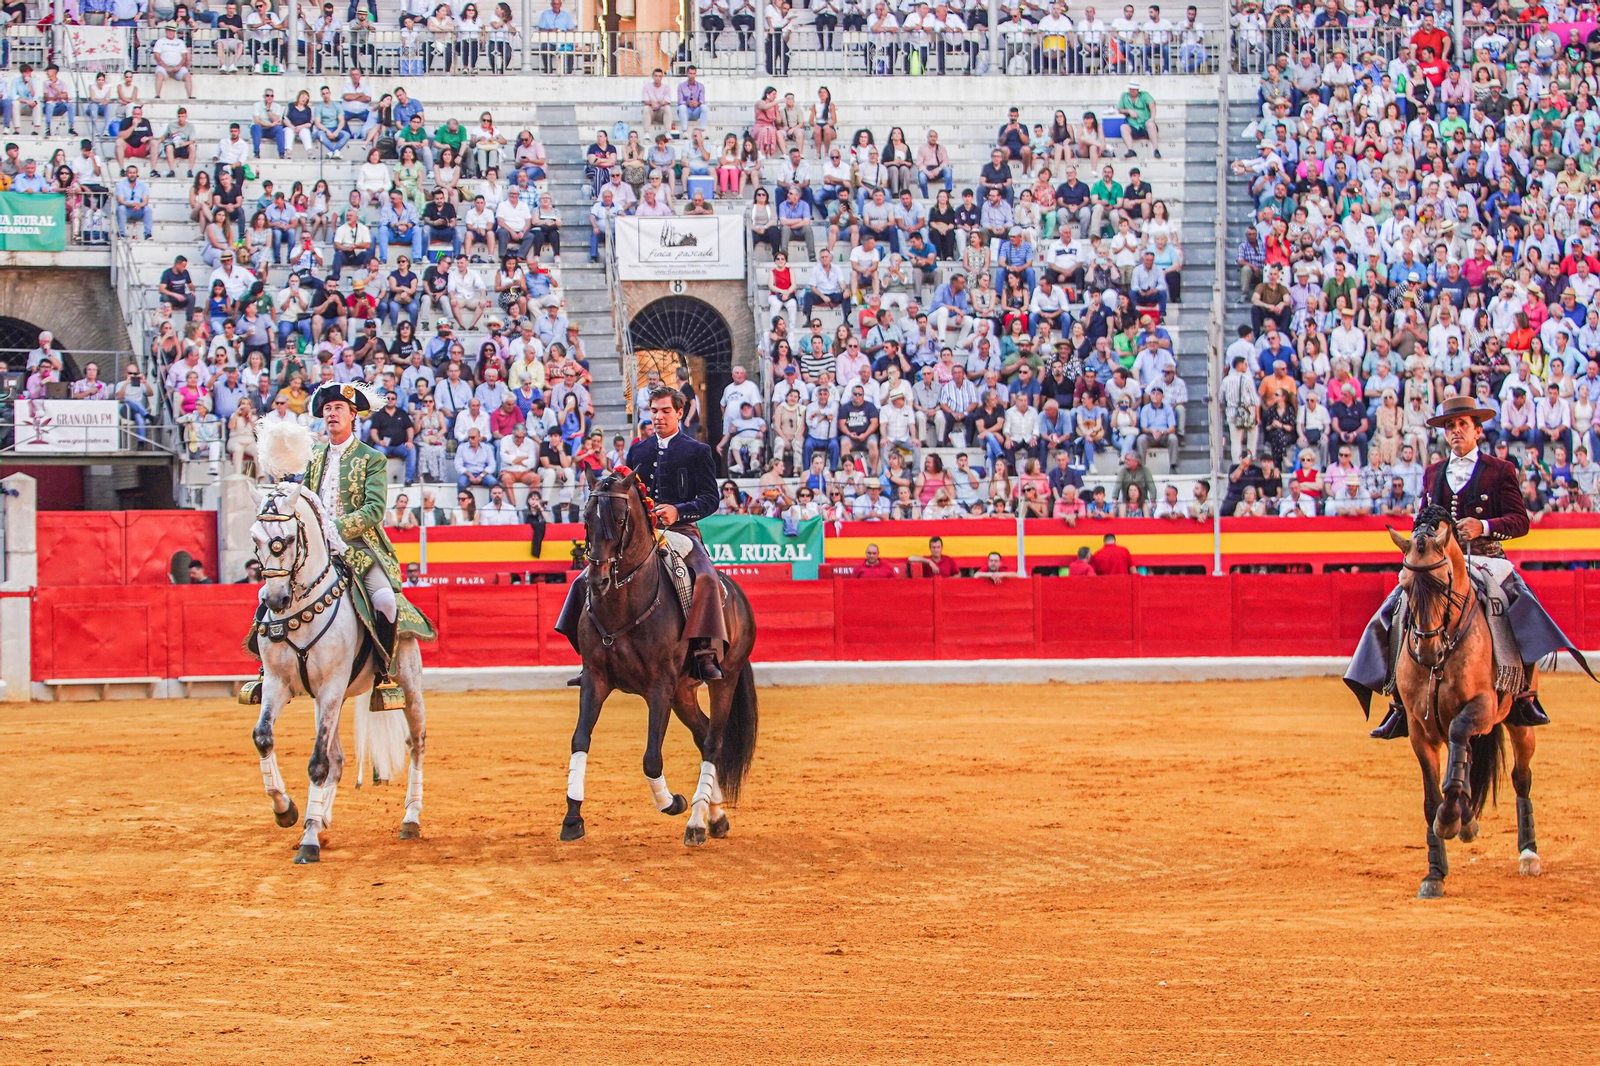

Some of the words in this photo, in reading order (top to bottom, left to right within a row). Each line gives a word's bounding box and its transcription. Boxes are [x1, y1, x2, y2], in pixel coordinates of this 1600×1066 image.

[13, 215, 56, 226] RURAL
[675, 248, 713, 260] pascade
[674, 280, 682, 292] 8
[56, 413, 98, 425] GRANADA
[101, 413, 112, 425] FM
[740, 544, 812, 561] RURAL
